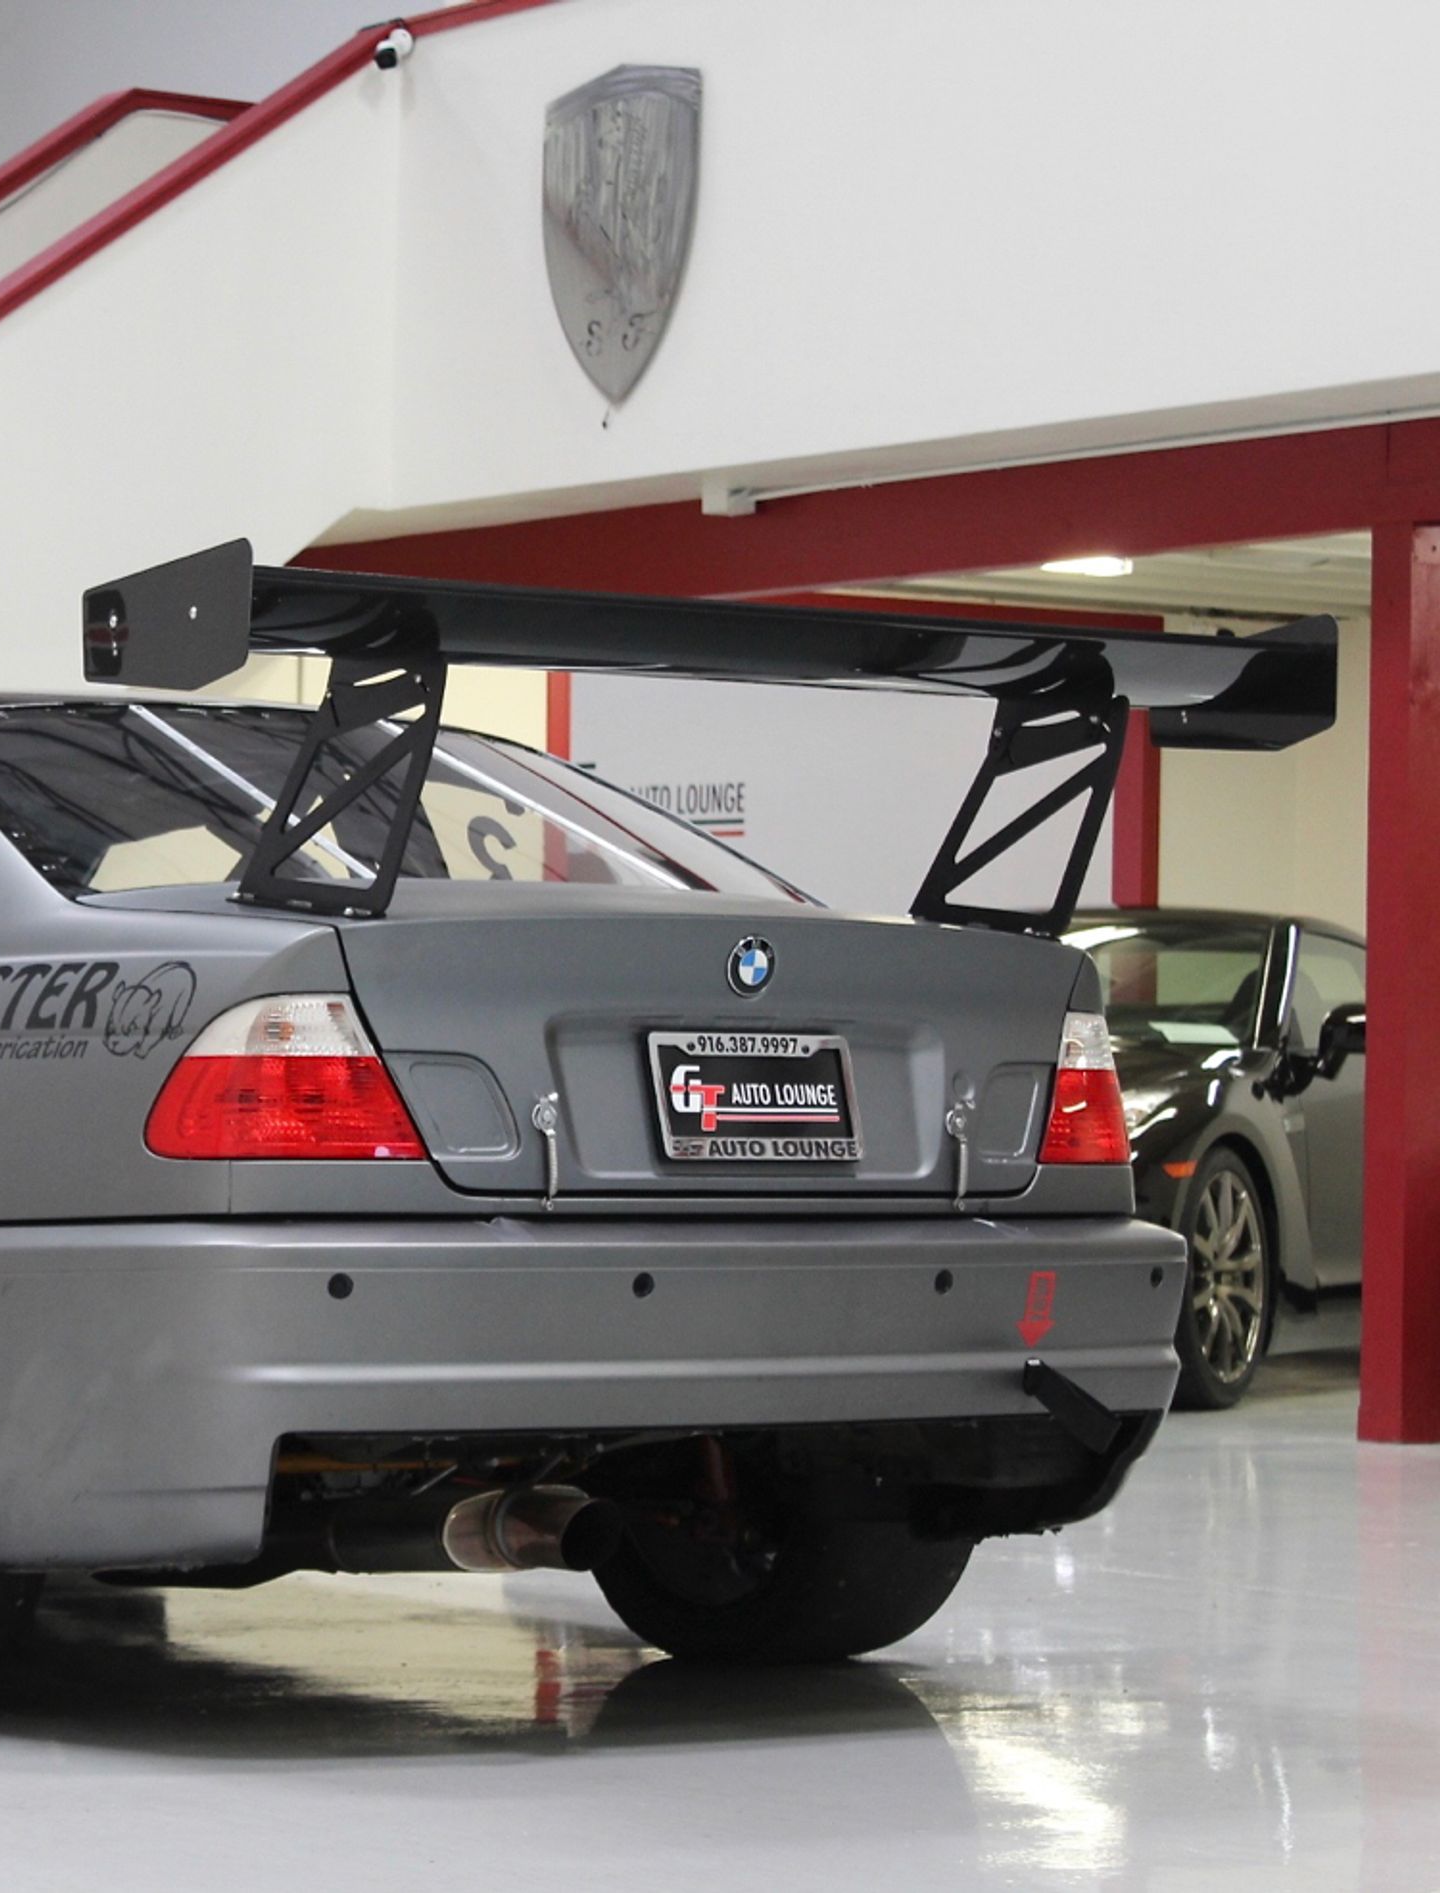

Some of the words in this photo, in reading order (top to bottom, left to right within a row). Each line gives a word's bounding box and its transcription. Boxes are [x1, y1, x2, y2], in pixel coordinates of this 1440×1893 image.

[630, 785, 672, 811] TO
[676, 782, 745, 814] LOUNGE
[696, 1035, 799, 1055] 916.387.9997
[670, 1064, 726, 1132] GT
[730, 1083, 772, 1106] AUTO
[774, 1083, 838, 1107] LOUNGE
[708, 1140, 766, 1158] AUTO
[773, 1141, 859, 1158] LOUNGE
